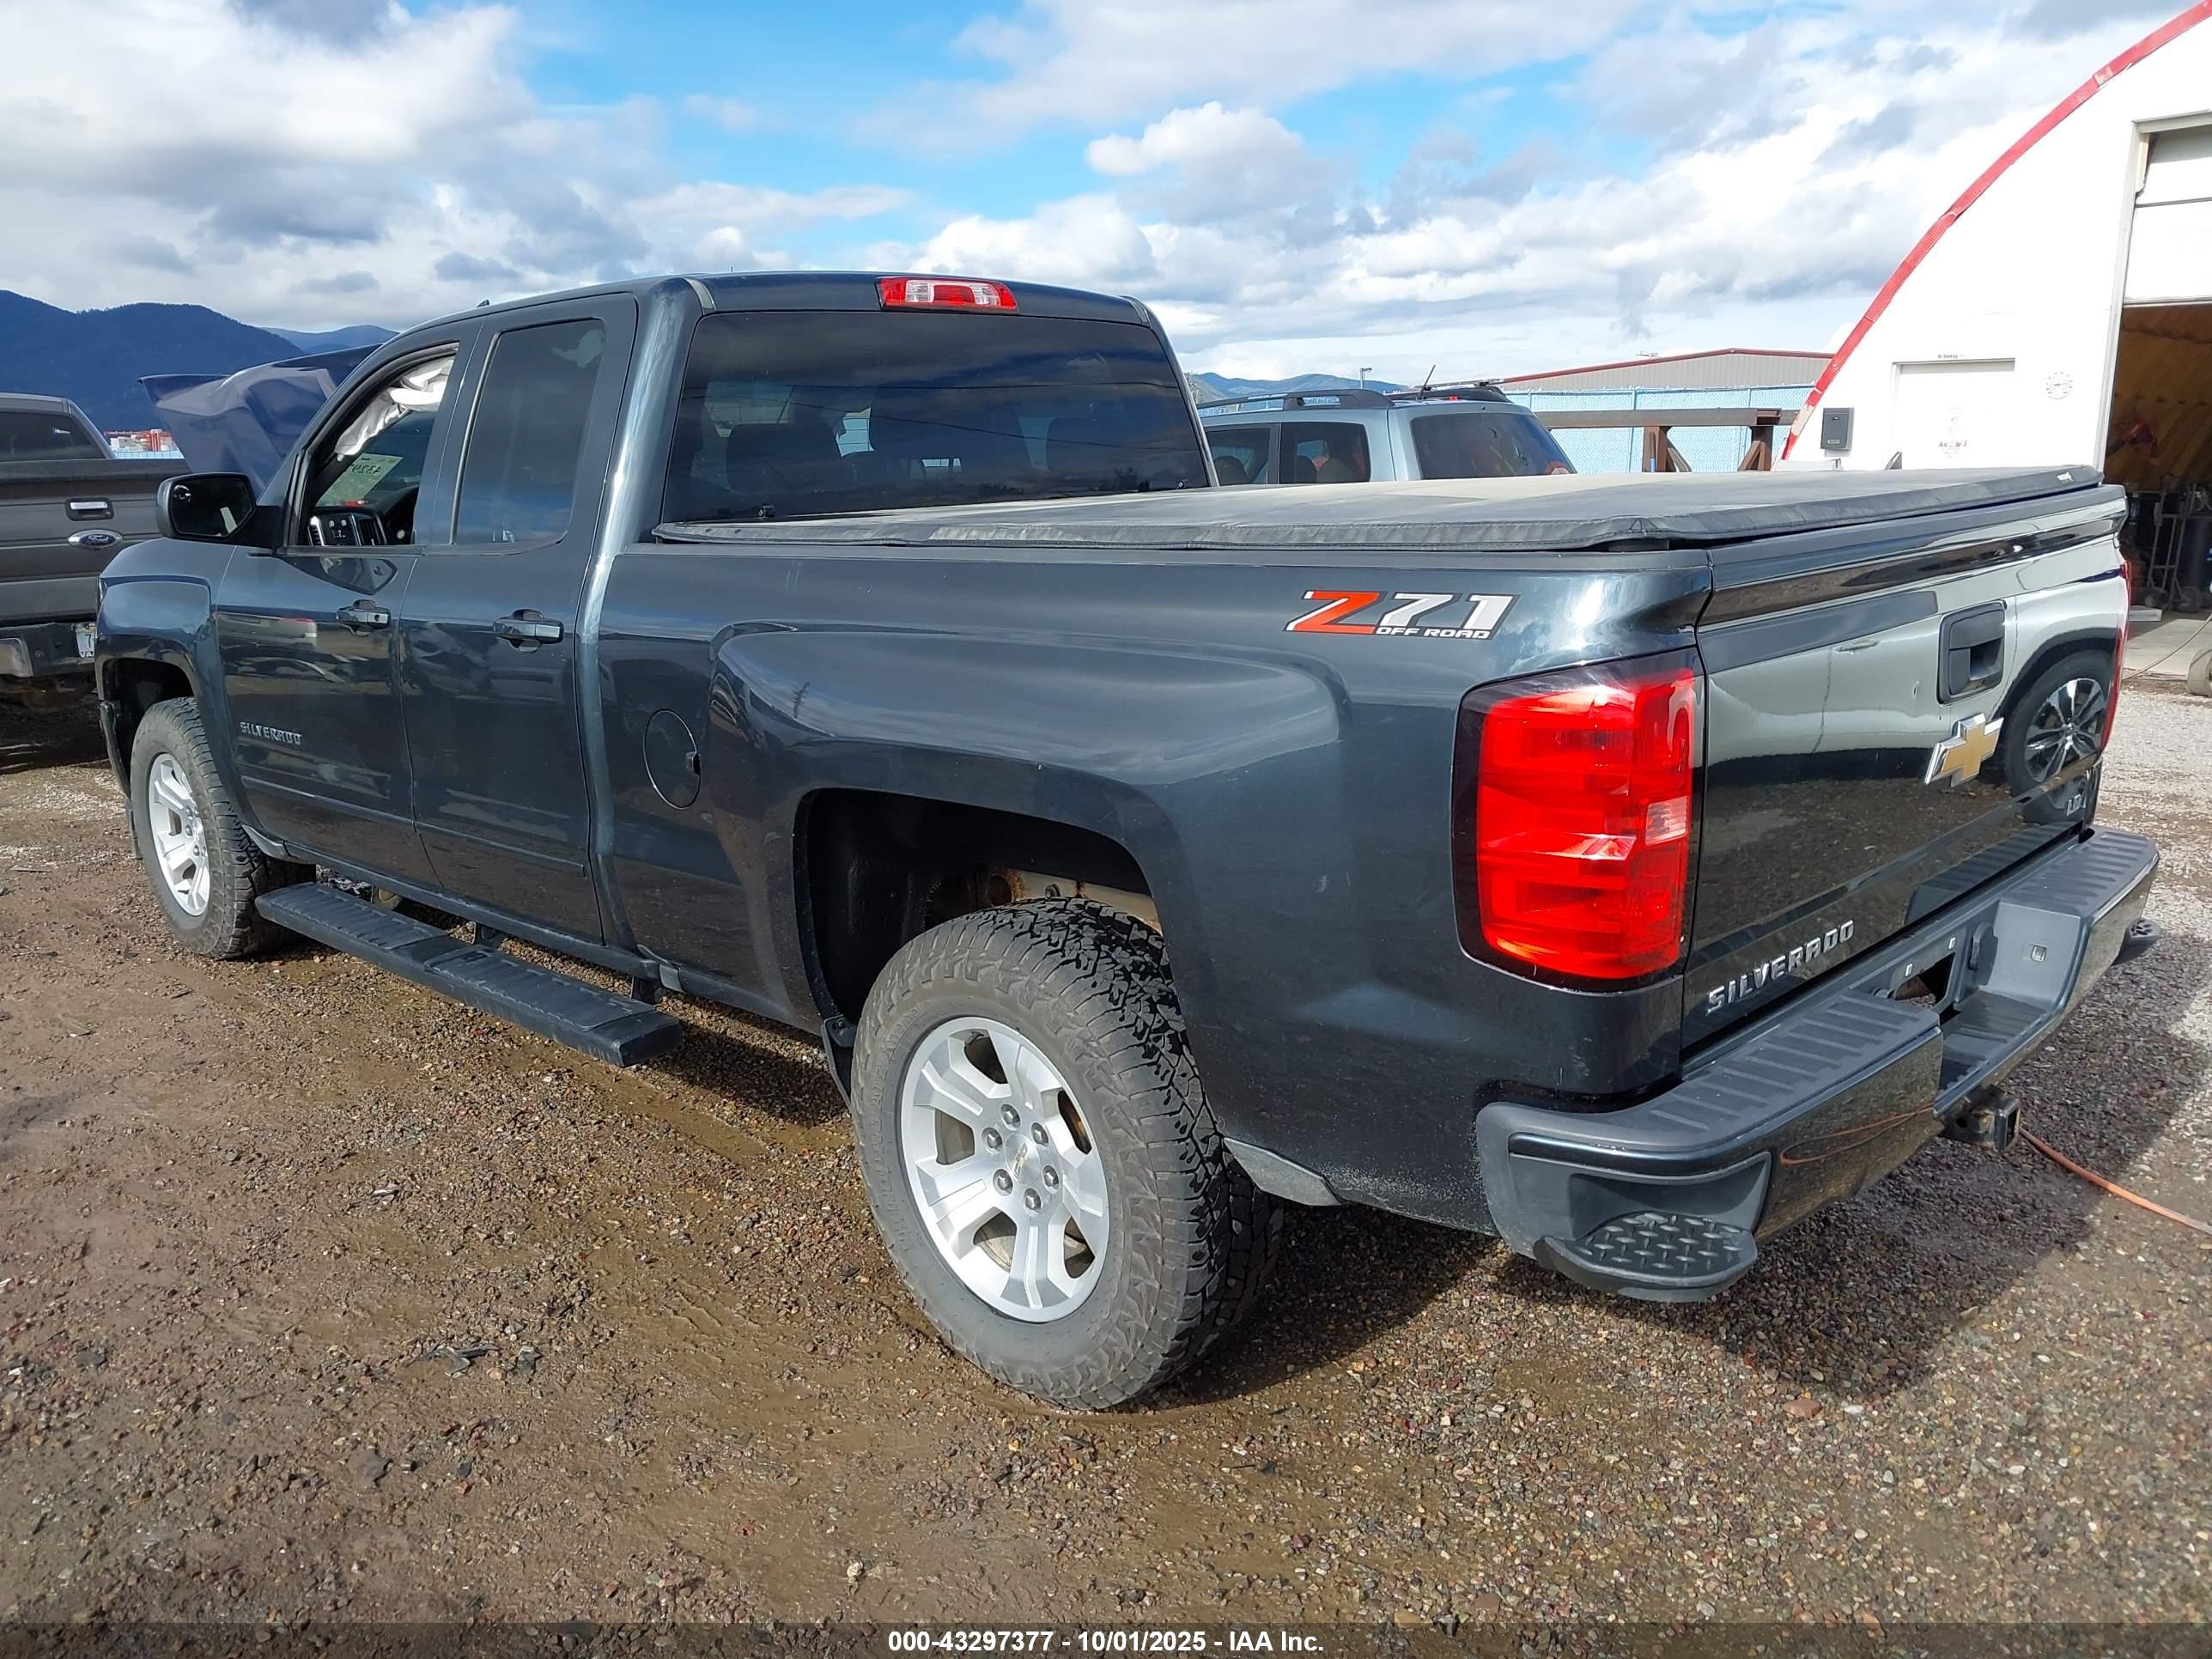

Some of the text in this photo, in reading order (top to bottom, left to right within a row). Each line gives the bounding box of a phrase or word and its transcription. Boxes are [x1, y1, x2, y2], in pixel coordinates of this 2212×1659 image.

[1284, 590, 1518, 635] Z71
[1375, 626, 1492, 640] OFF ROAD
[240, 721, 303, 746] SILVERADO
[1706, 920, 1855, 1015] SILVERADO
